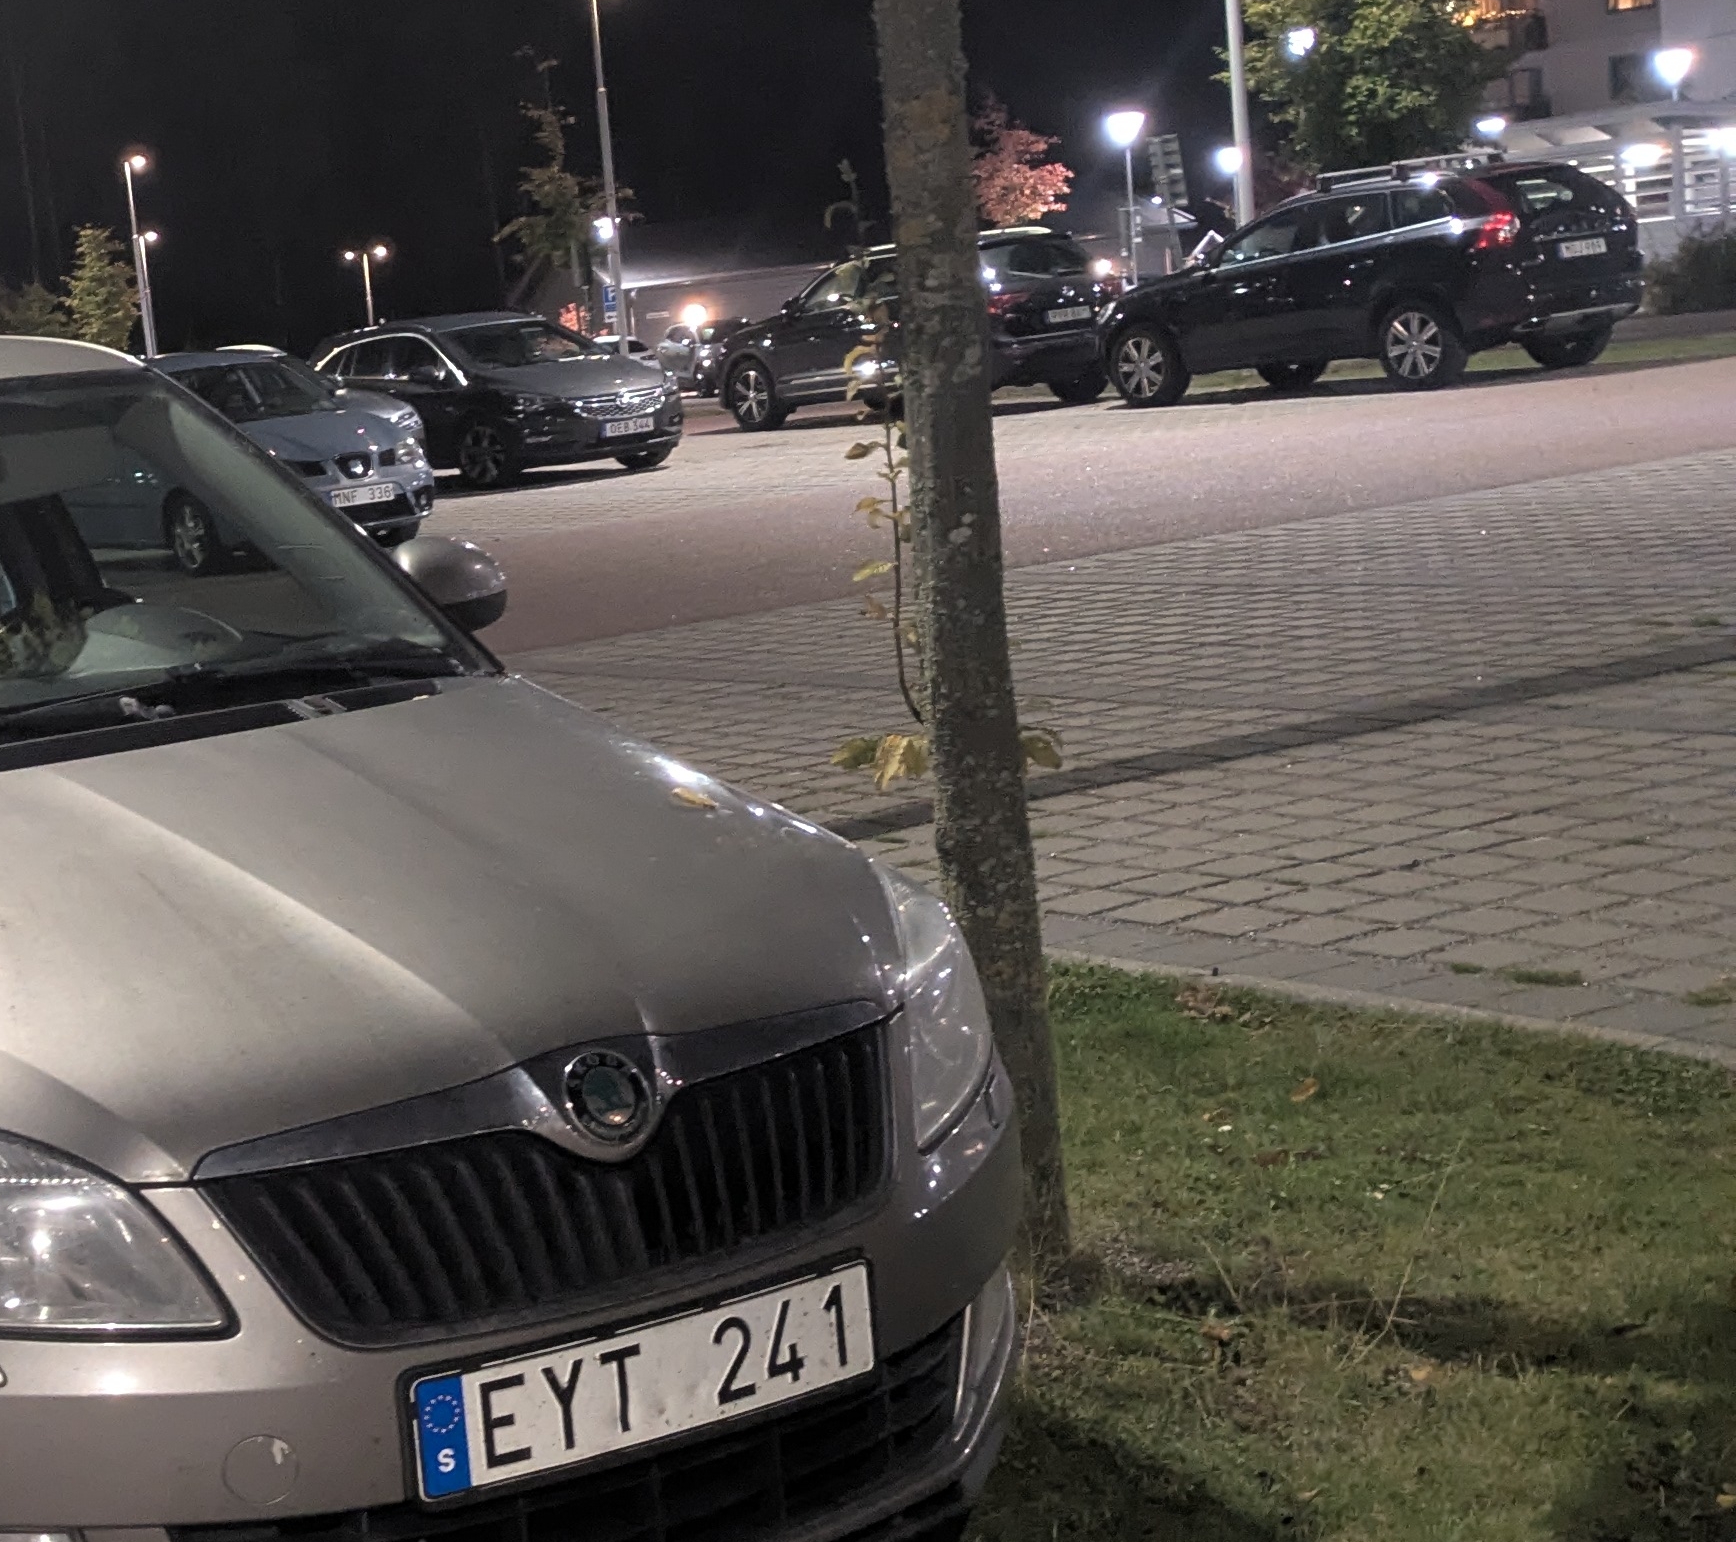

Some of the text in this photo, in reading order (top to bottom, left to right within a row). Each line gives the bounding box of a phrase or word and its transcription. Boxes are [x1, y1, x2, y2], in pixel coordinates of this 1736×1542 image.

[333, 485, 392, 505] MNF 336
[478, 1283, 849, 1469] EYT 241
[437, 1447, 456, 1473] S
